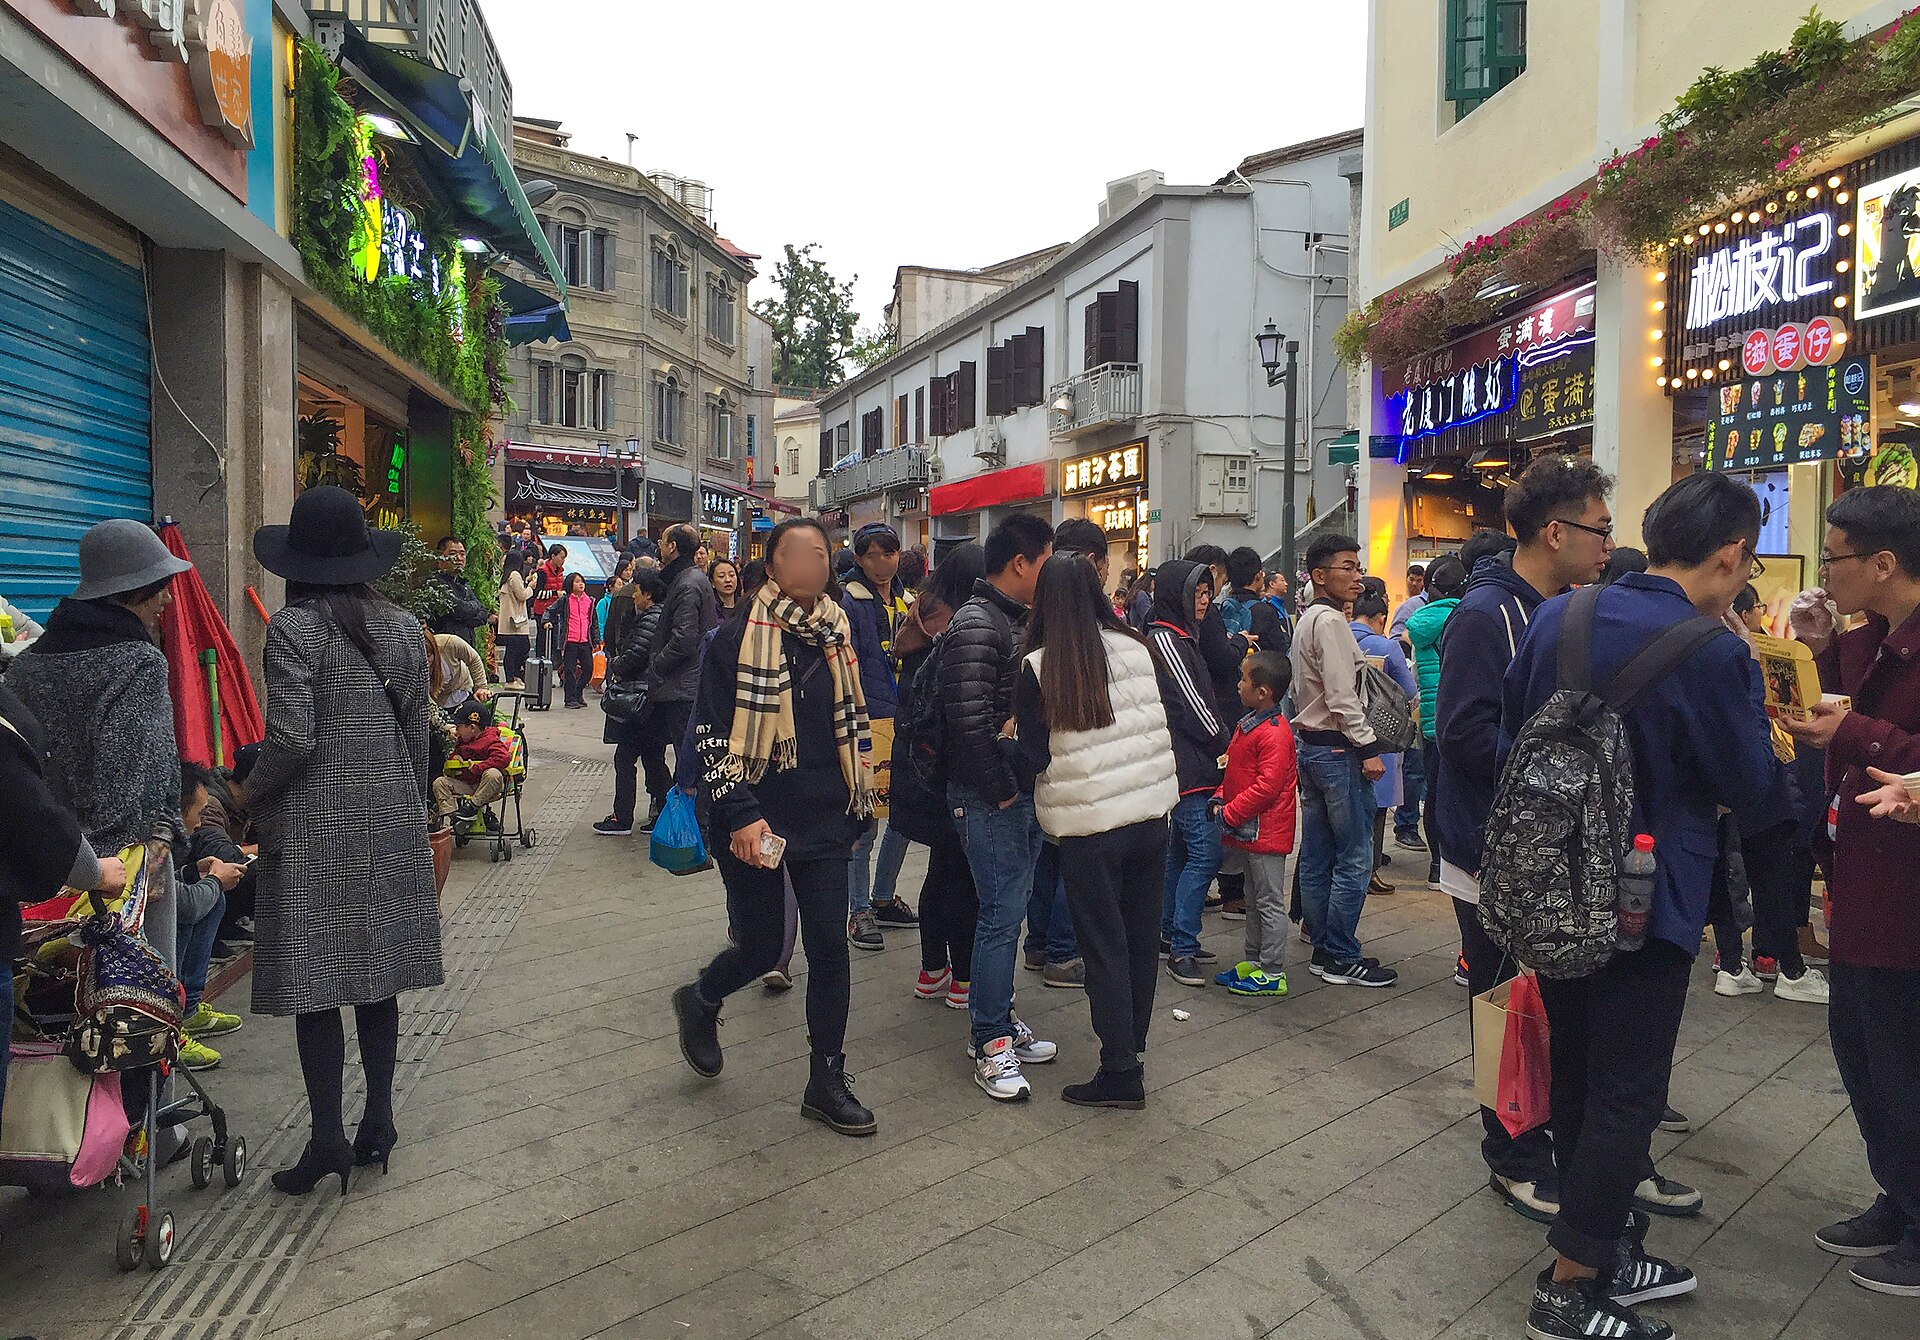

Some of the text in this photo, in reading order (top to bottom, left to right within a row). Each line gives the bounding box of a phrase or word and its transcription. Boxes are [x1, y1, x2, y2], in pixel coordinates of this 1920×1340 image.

[1686, 212, 1833, 330] 松枝记
[1745, 326, 1831, 367] 滋蛋仔
[1402, 359, 1501, 436] 老厦门酸奶
[1065, 447, 1139, 492] 闽南沙茶面
